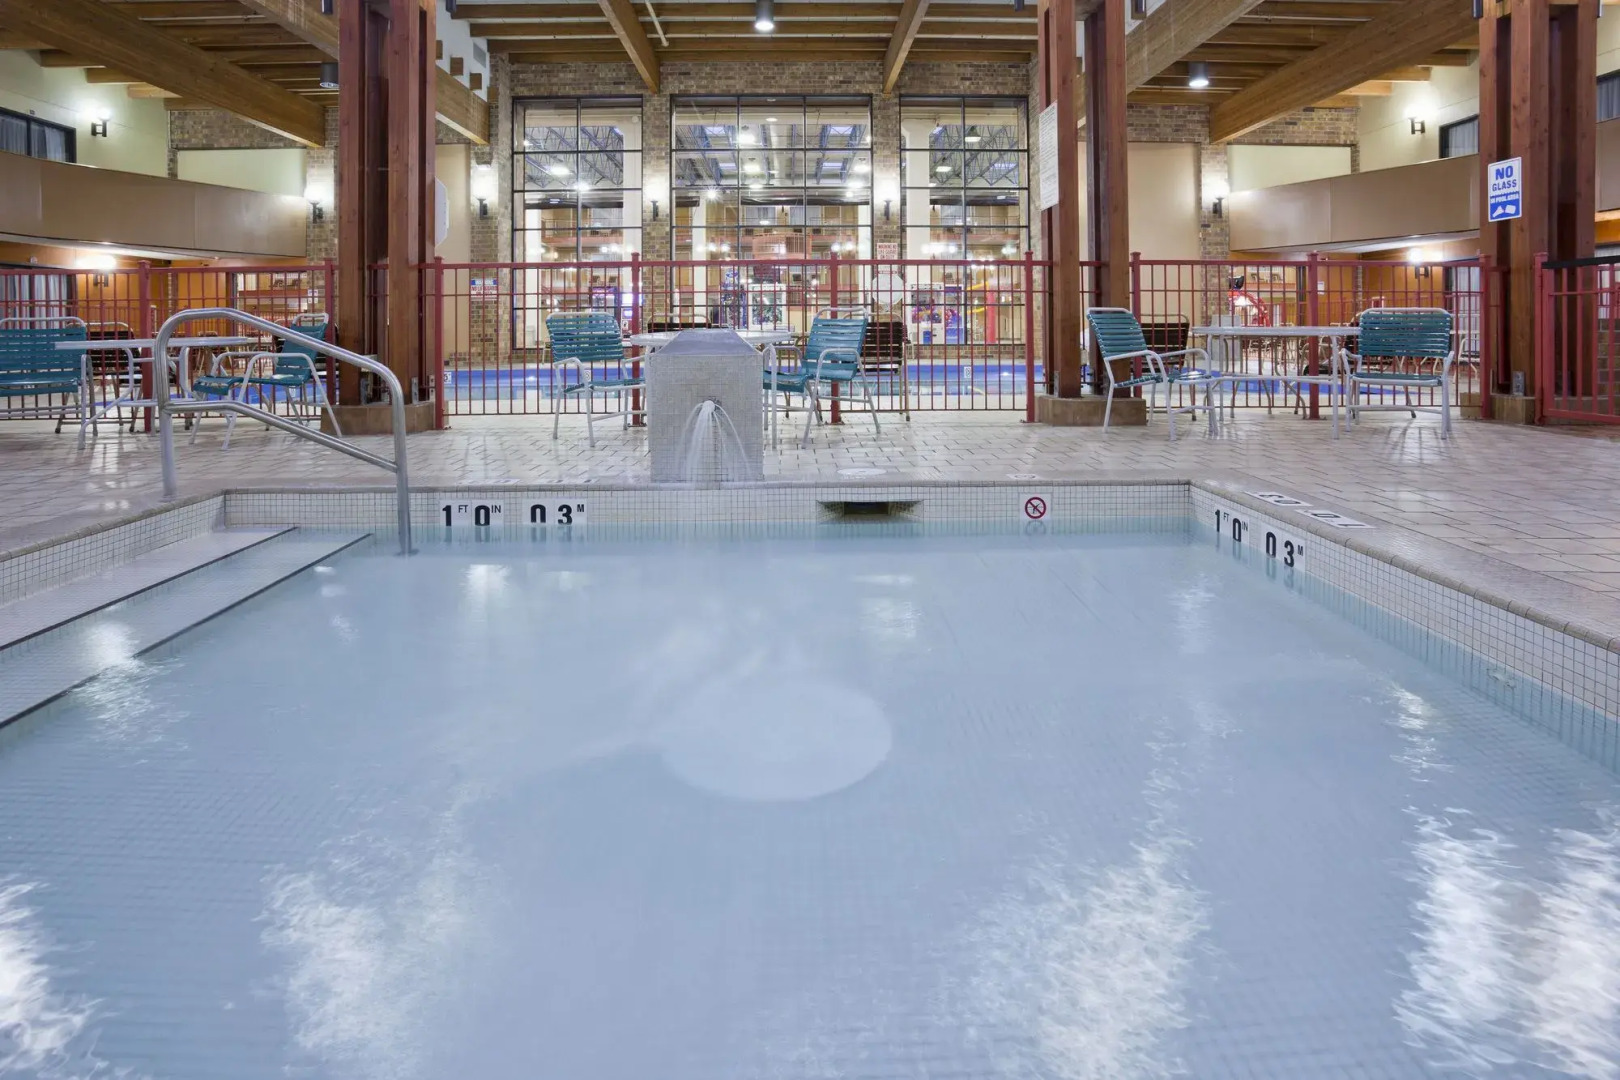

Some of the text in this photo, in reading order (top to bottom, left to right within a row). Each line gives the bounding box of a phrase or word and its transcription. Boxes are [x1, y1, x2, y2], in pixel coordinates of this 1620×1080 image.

[1495, 166, 1513, 180] NO
[1492, 179, 1517, 192] GLASS
[442, 504, 501, 526] 1 FT 0 IN
[577, 503, 585, 513] M
[1215, 509, 1221, 532] 1
[1223, 512, 1230, 522] FT
[1232, 517, 1242, 542] 0
